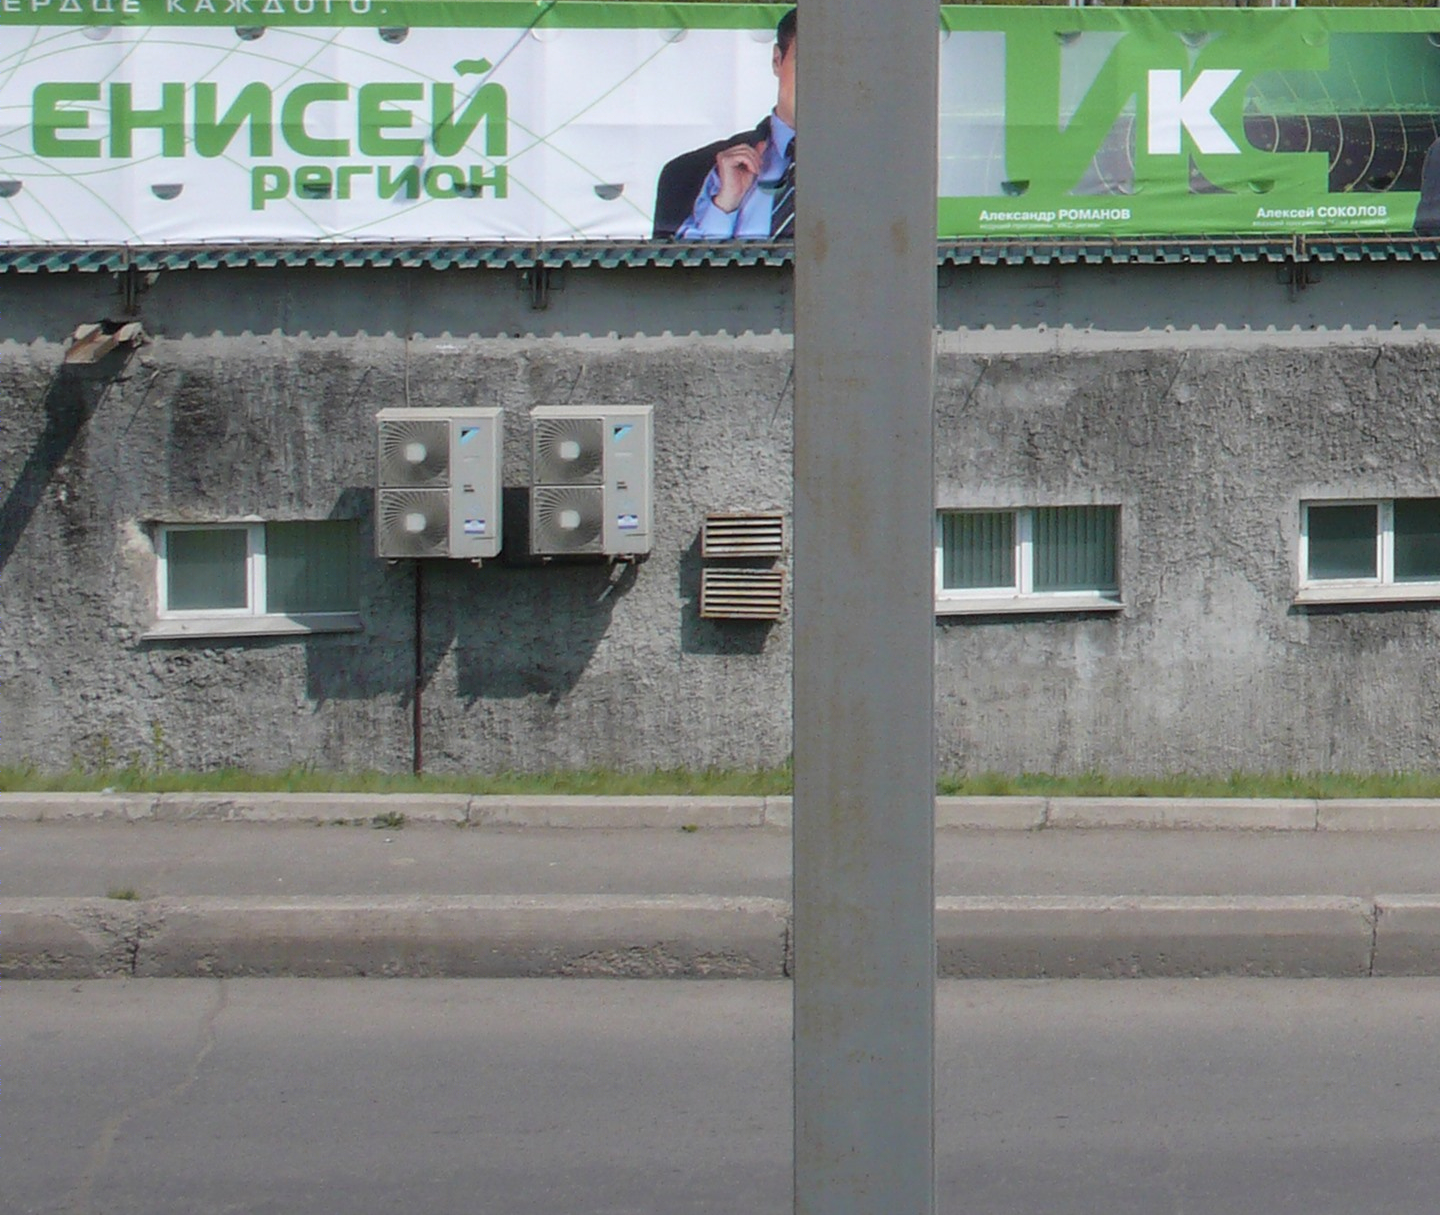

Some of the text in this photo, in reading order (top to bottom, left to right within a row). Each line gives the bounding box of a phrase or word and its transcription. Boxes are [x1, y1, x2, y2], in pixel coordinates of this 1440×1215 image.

[32, 58, 508, 160] ЕНИСЕЙ
[251, 164, 508, 211] регион
[979, 208, 1131, 222] Александр РОМАНОВ
[1256, 205, 1387, 218] Алексей СОКОЛОВ
